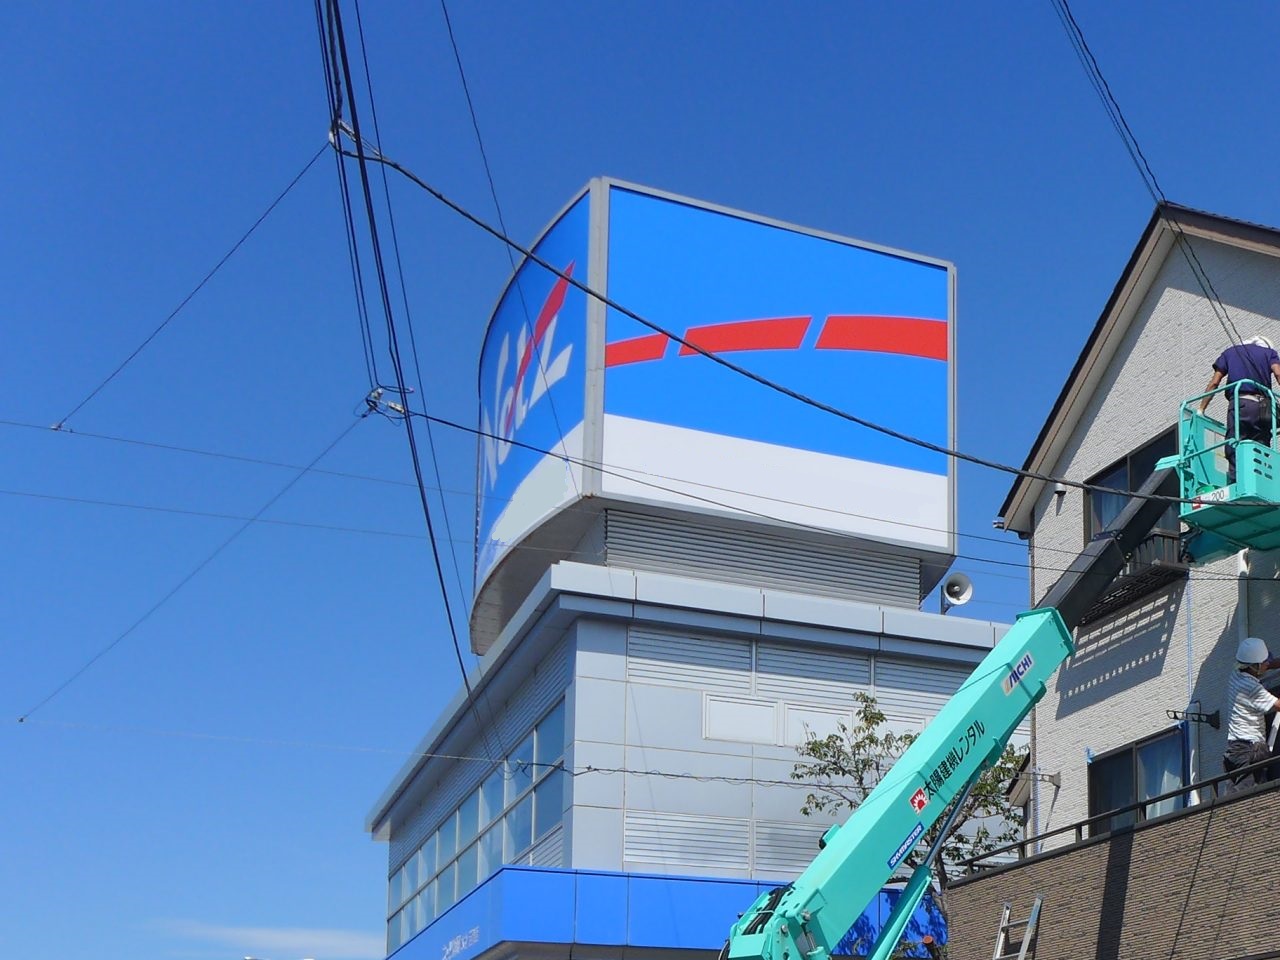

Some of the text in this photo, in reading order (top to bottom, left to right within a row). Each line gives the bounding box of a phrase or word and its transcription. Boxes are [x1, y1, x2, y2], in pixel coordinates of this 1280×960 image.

[1009, 654, 1032, 689] AICHI
[923, 719, 986, 801] 太陽建機レンタル
